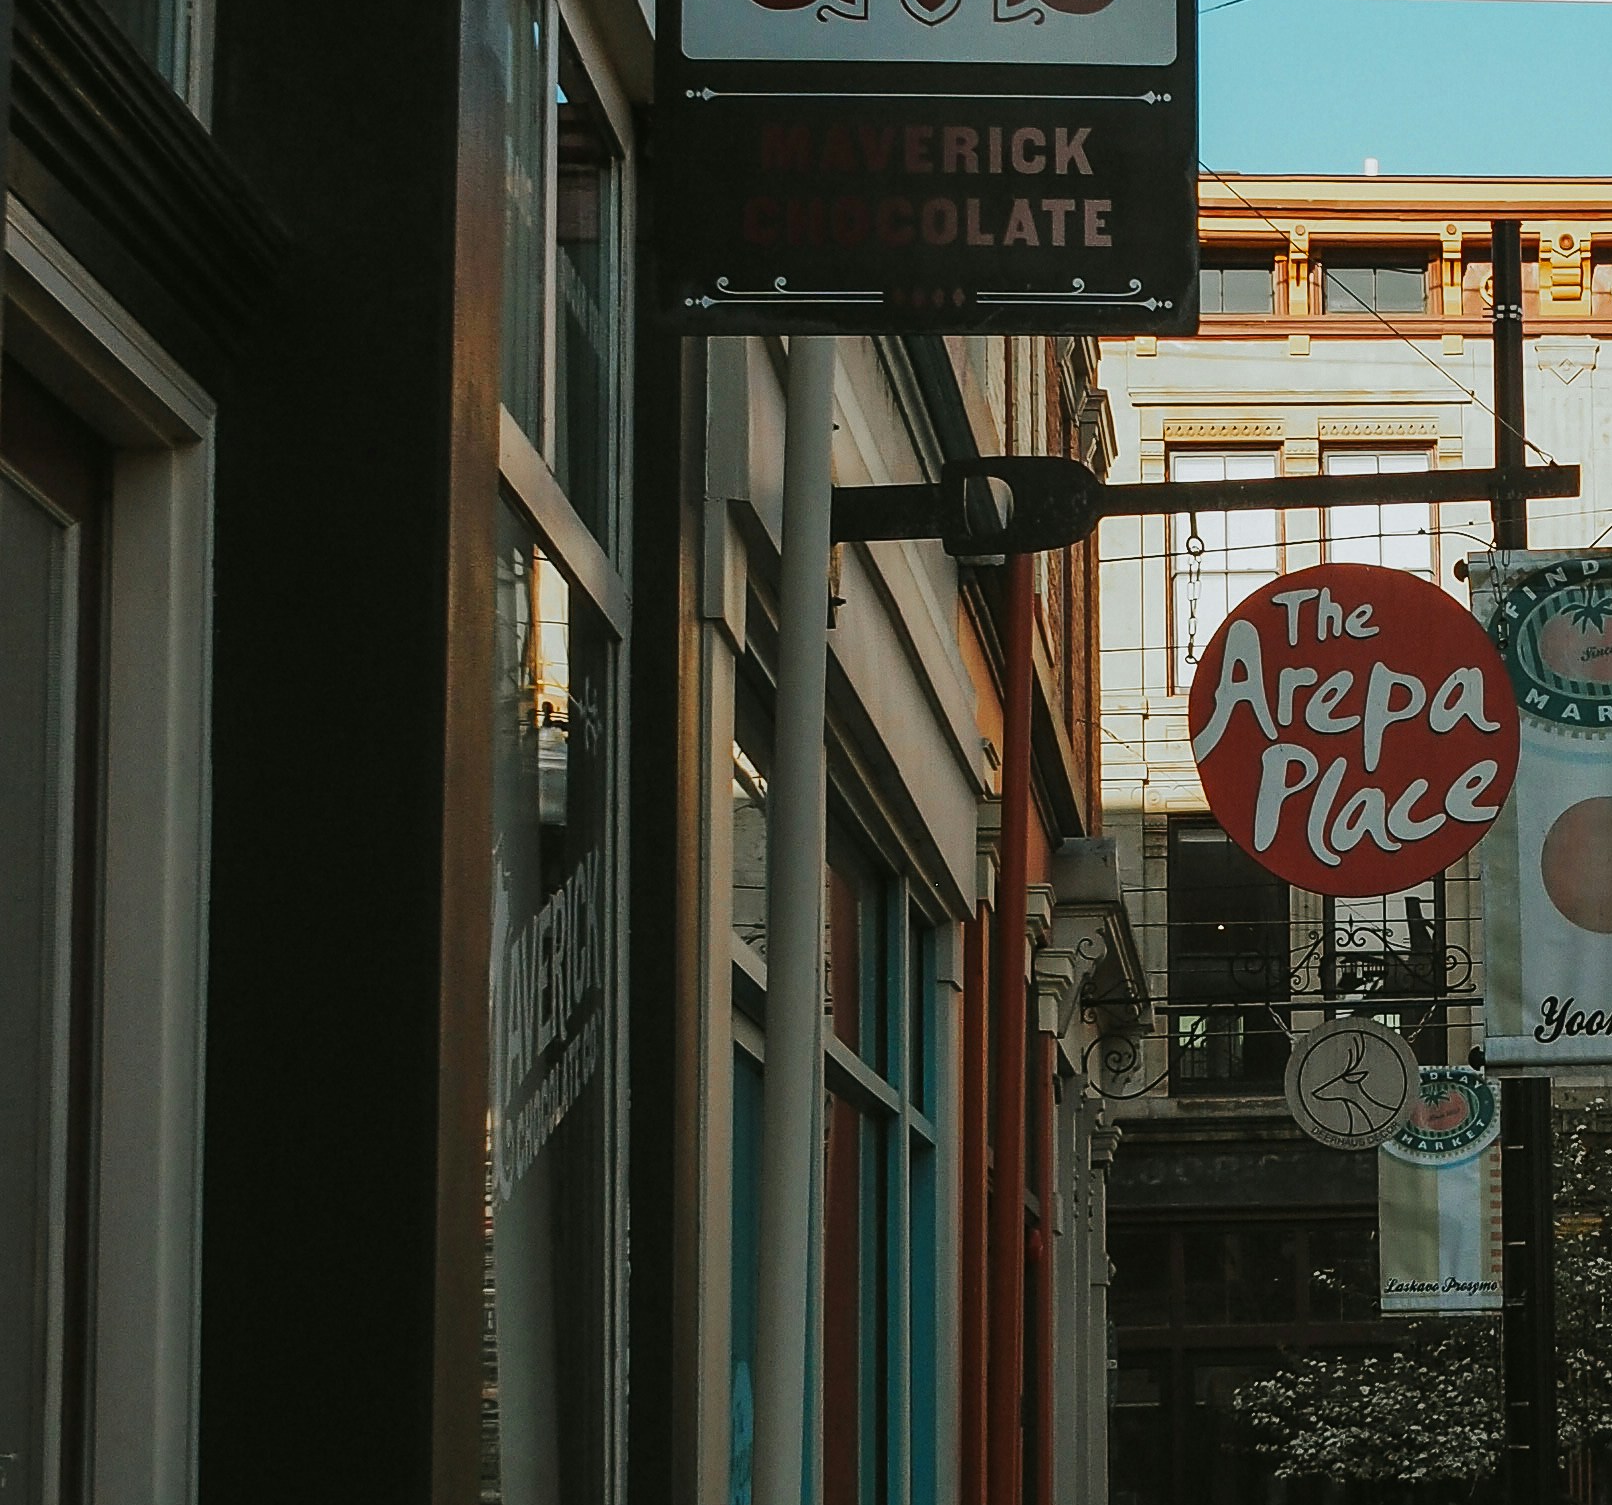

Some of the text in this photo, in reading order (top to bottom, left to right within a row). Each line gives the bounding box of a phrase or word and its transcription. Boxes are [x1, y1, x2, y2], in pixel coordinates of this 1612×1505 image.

[761, 123, 1094, 175] MAVERICK
[743, 197, 1113, 247] CHOCOLATE
[1271, 587, 1380, 646] The
[1191, 619, 1501, 773] Arepa
[1254, 743, 1500, 866] Place
[1420, 1072, 1482, 1088] DLAY
[1402, 1119, 1485, 1150] MARKET
[1384, 1277, 1440, 1293] Laskavo
